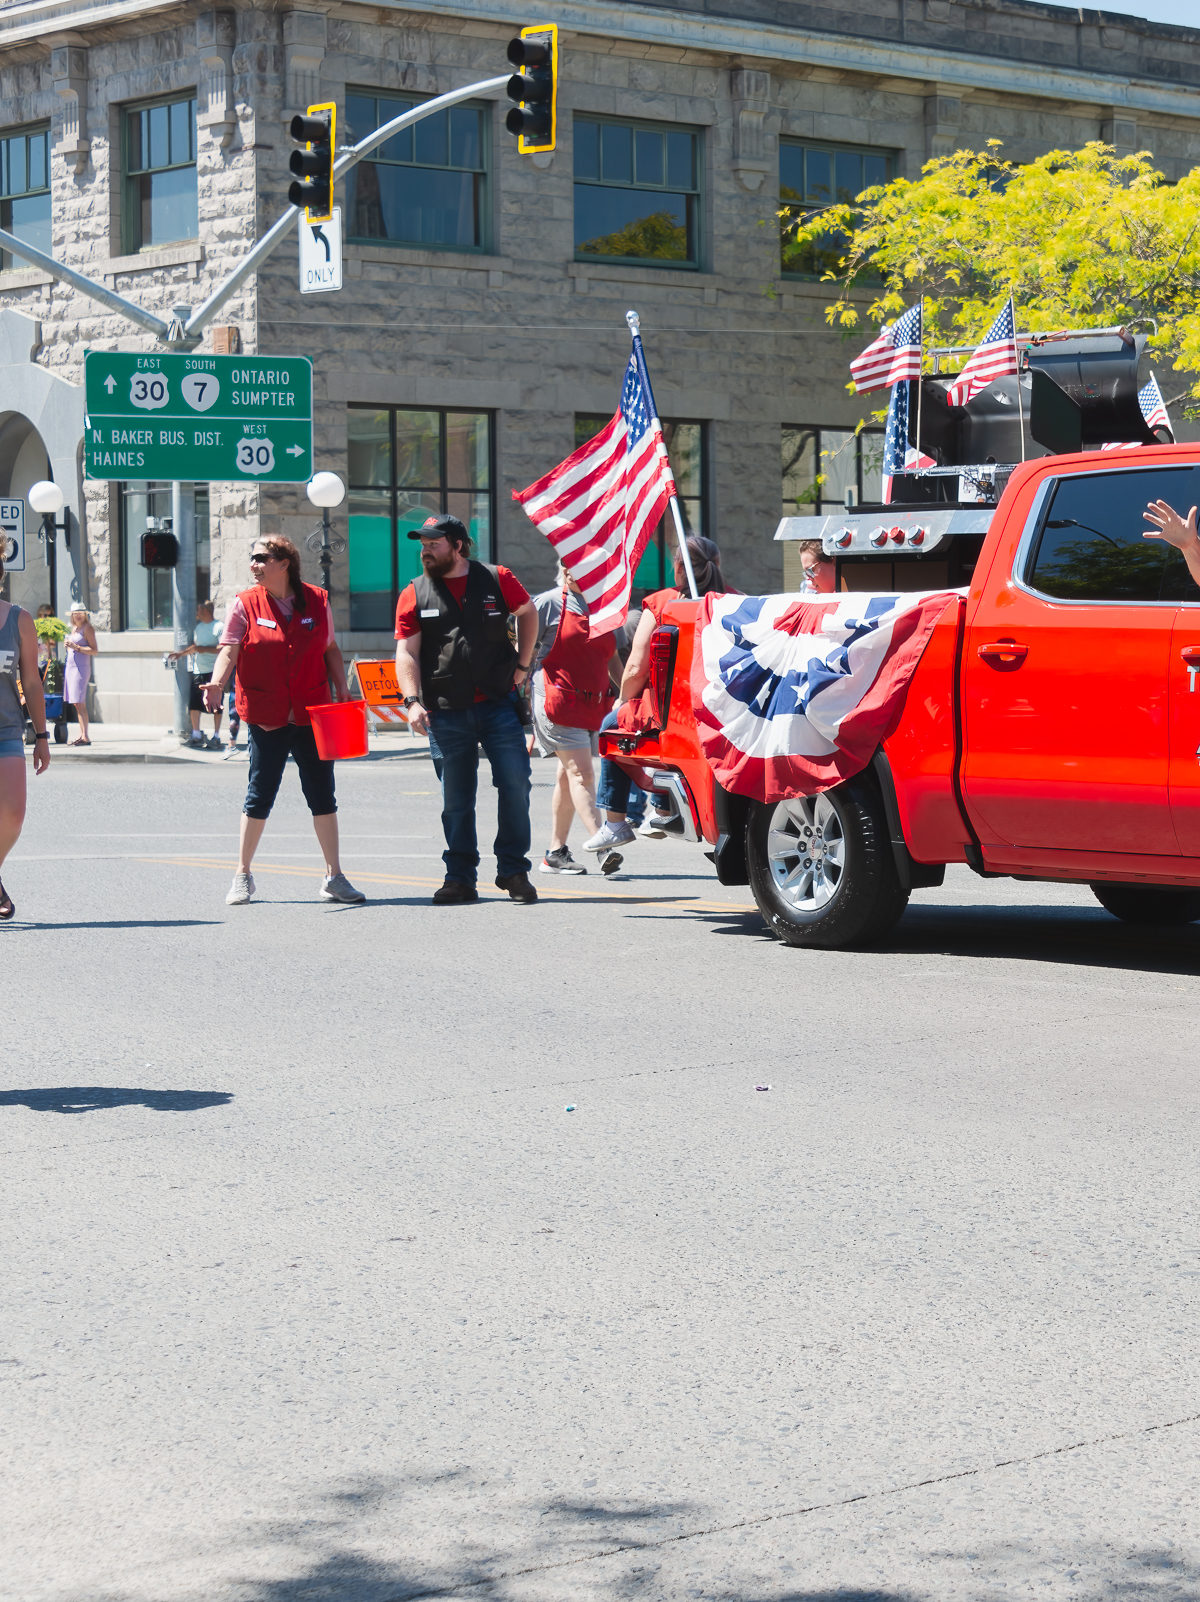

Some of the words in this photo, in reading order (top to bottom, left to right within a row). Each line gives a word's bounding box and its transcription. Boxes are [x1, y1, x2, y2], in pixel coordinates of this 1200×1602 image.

[307, 267, 335, 284] ONLY
[137, 358, 161, 369] EAST
[185, 359, 216, 370] SOUTH
[231, 369, 290, 385] ONTARIO
[134, 380, 165, 401] 30
[194, 382, 208, 403] 7
[231, 390, 296, 406] SUMPTER
[242, 424, 268, 435] WEST
[93, 429, 105, 444] N.
[112, 429, 154, 445] BAKER
[160, 430, 188, 446] BUS.
[194, 431, 224, 447] DIST.
[93, 451, 145, 467] HAINES
[241, 445, 271, 467] 30
[365, 679, 400, 691] DETOU
